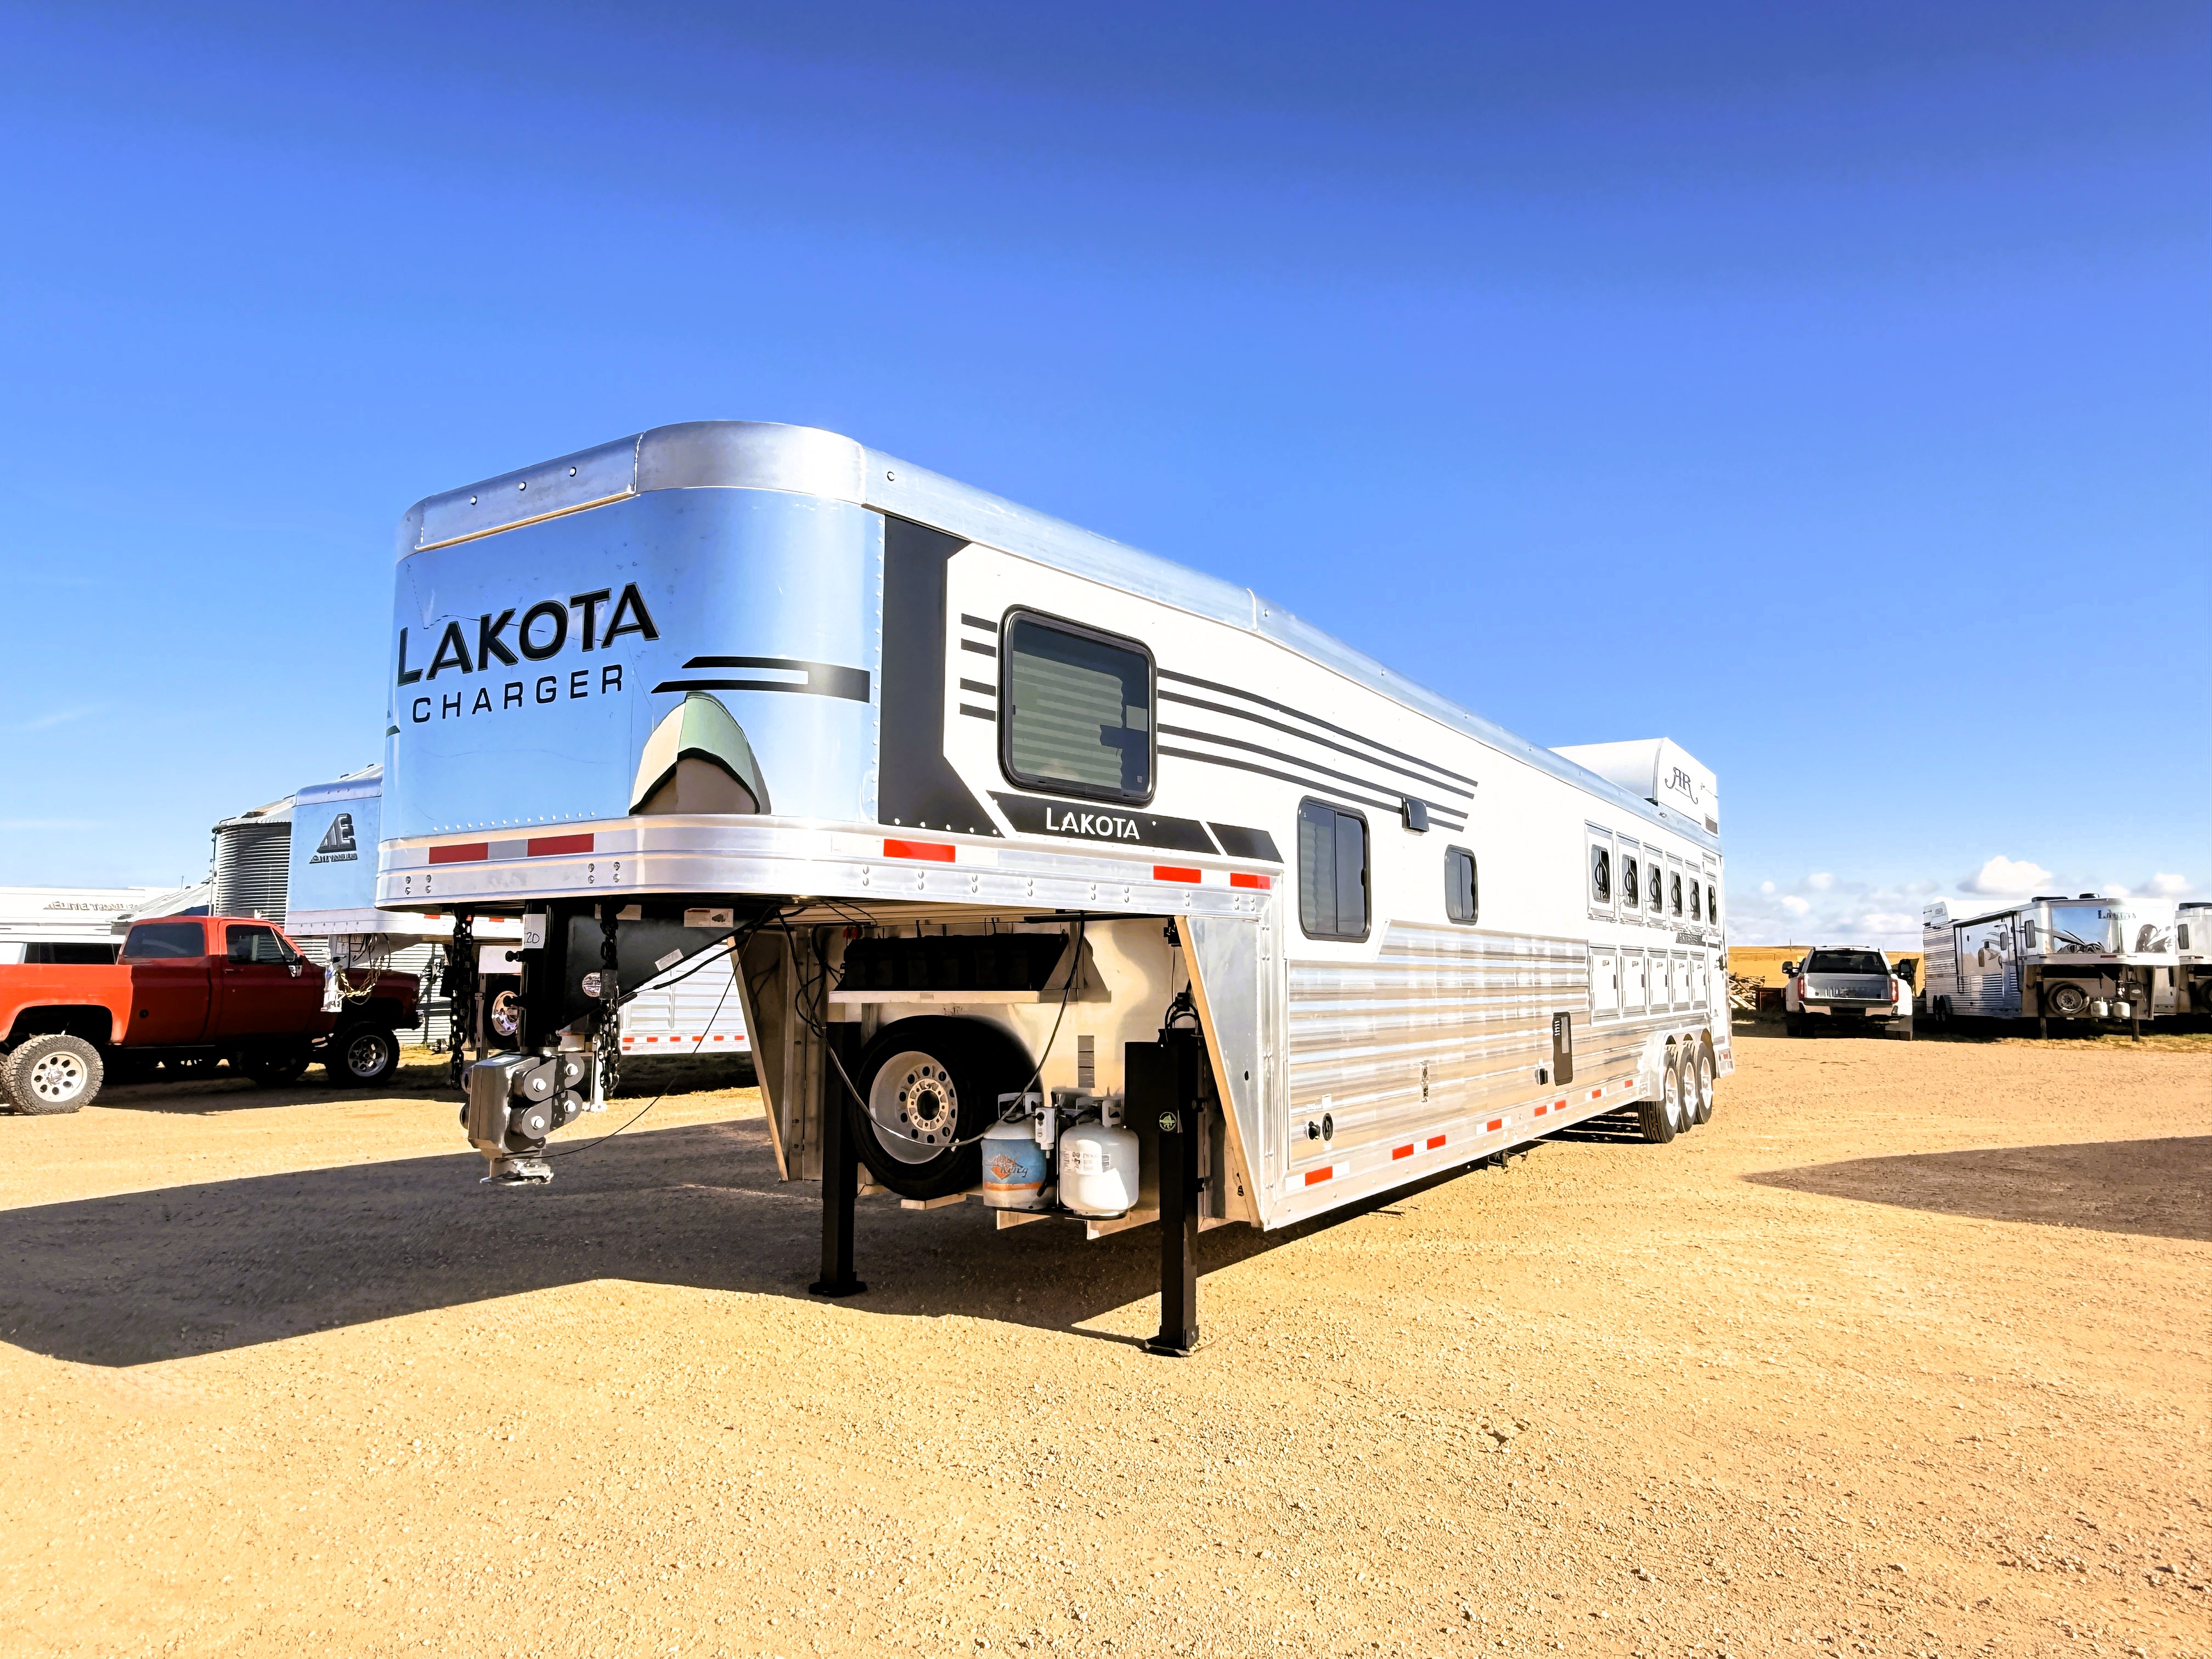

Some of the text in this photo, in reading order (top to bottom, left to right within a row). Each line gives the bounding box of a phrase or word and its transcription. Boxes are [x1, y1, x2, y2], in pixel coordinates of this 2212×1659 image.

[397, 582, 660, 686] LAKOTA
[413, 664, 623, 723] CHARGER
[1046, 807, 1140, 840] LAKOTA
